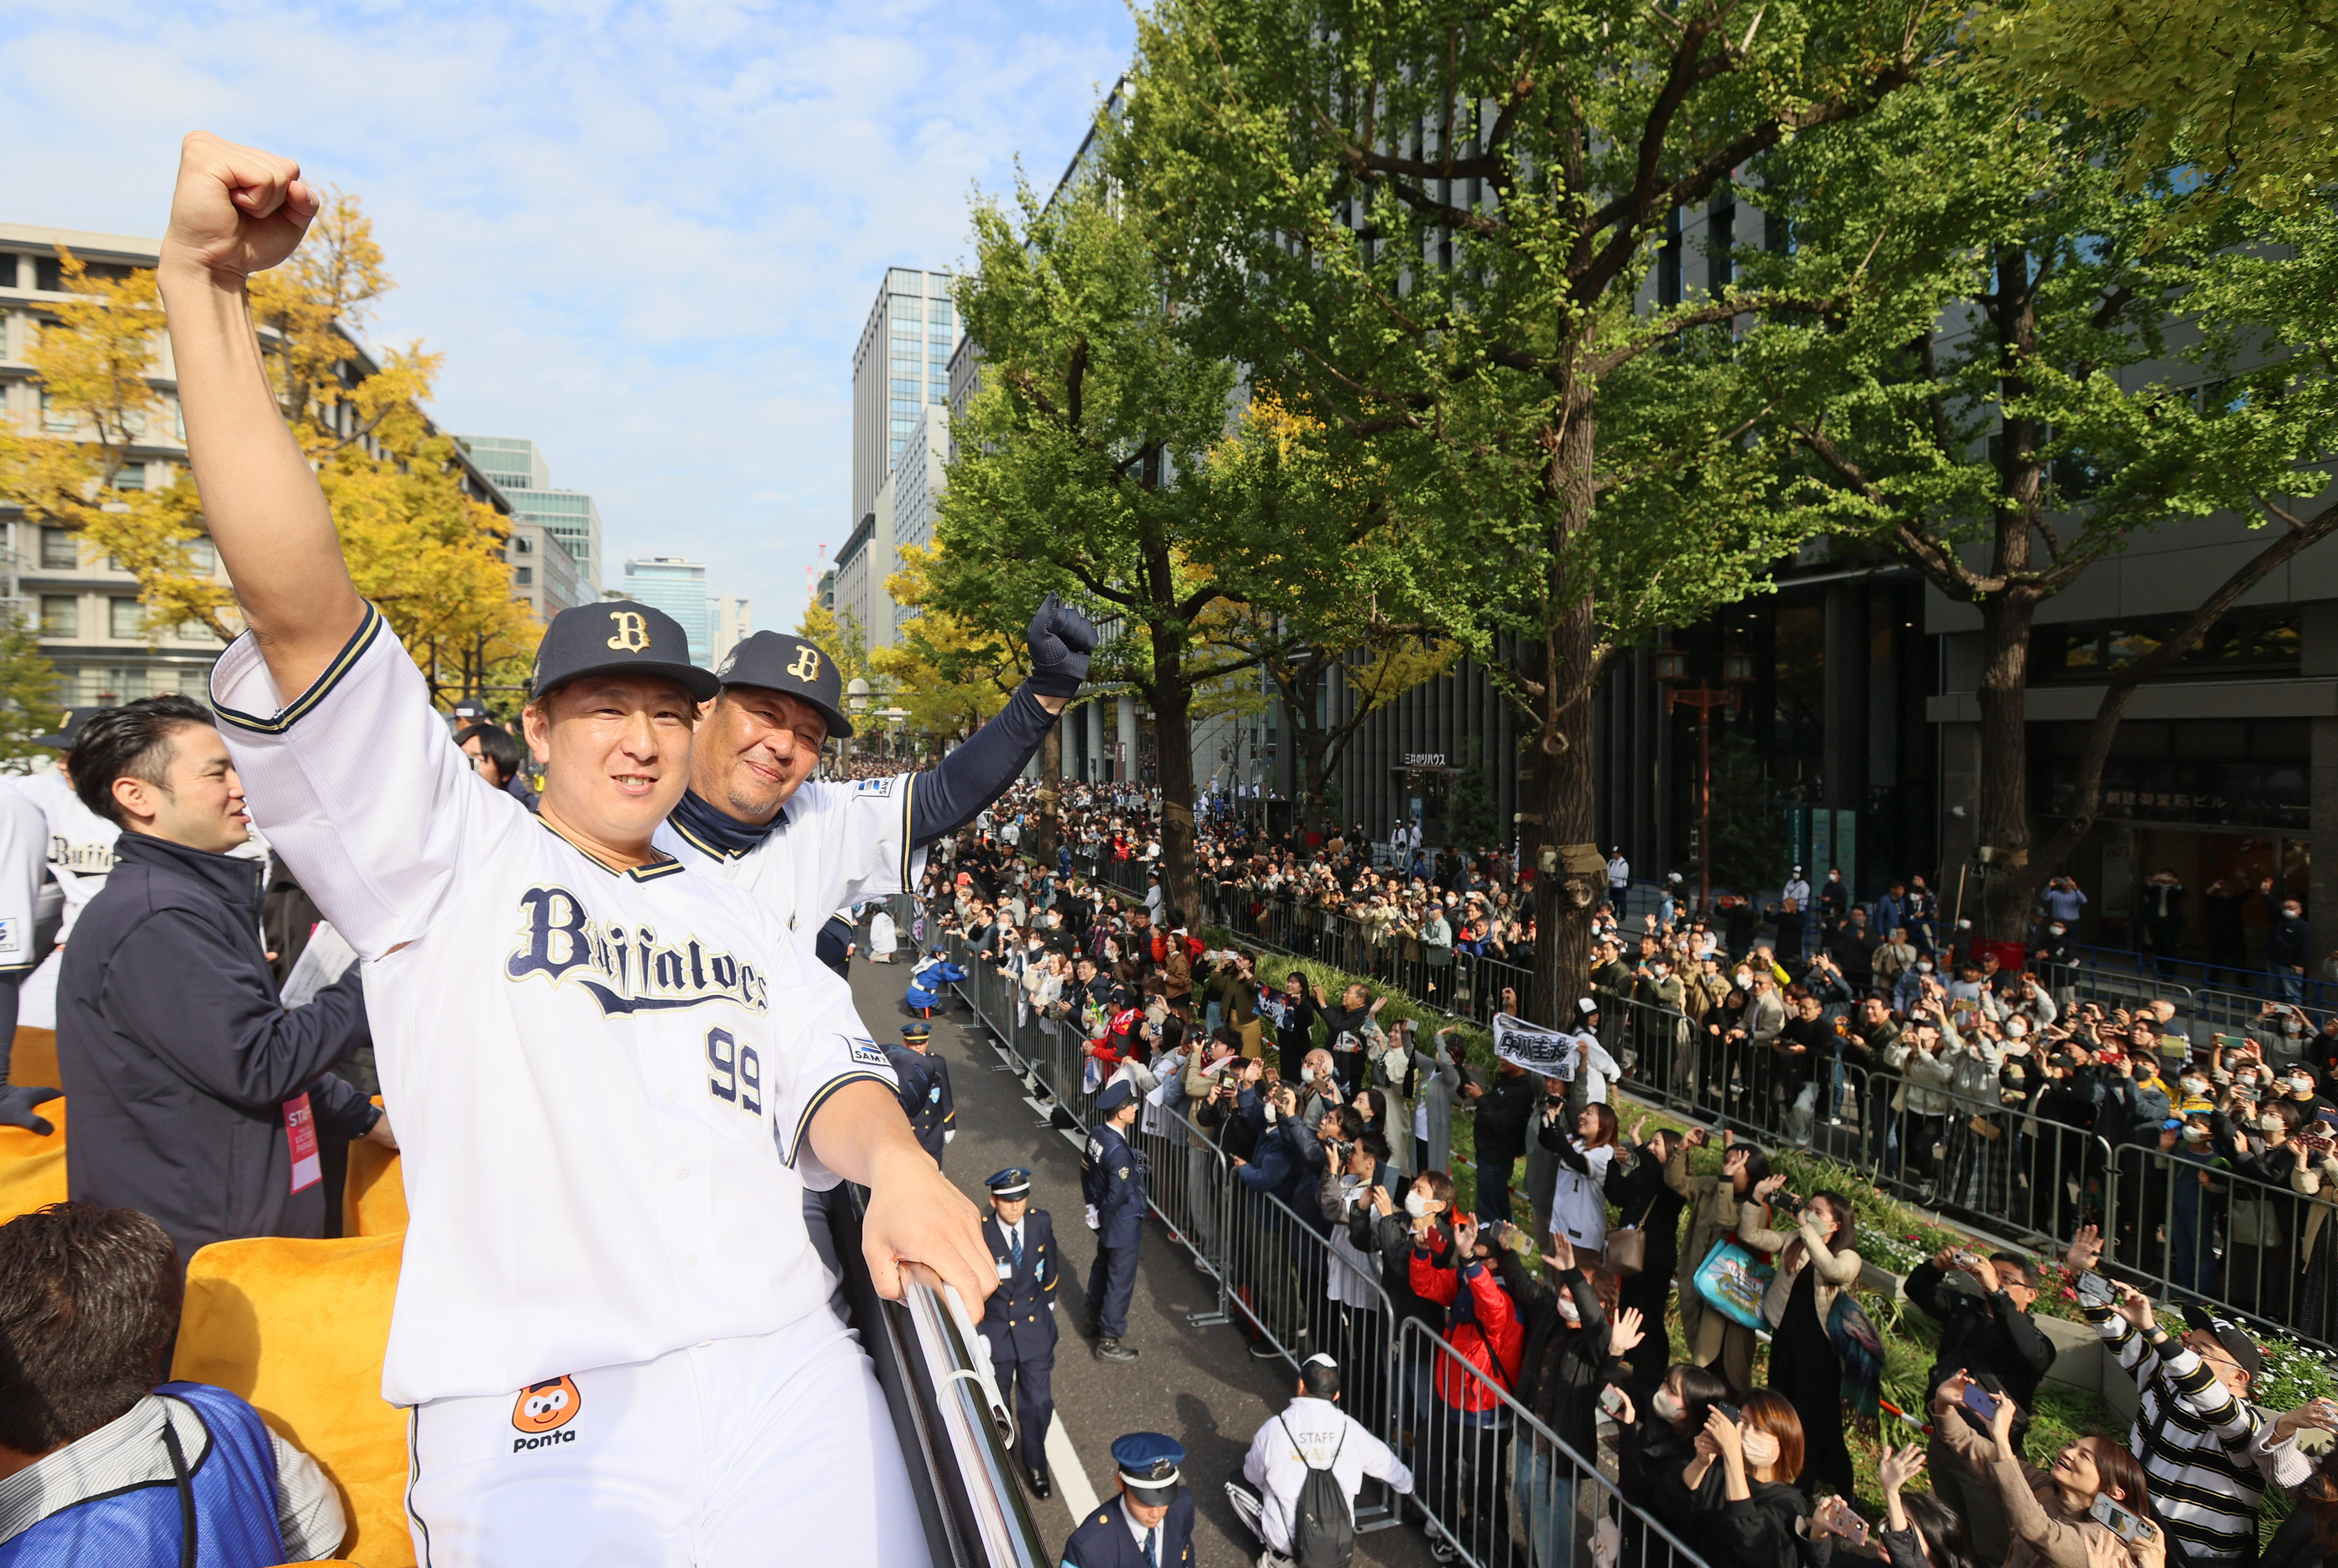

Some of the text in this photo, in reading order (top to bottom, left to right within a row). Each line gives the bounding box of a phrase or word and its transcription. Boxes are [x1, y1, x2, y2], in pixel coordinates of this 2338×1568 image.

[607, 611, 651, 653] B
[787, 645, 823, 683] B
[1405, 753, 1445, 765] 三井のリハウス
[505, 883, 770, 1018] Buffaloes
[1499, 1031, 1570, 1063] 中川圭太
[703, 1022, 762, 1120] 99
[1573, 1179, 1579, 1193] 1
[513, 1429, 576, 1453] Ponta
[1299, 1432, 1335, 1444] STAFF
